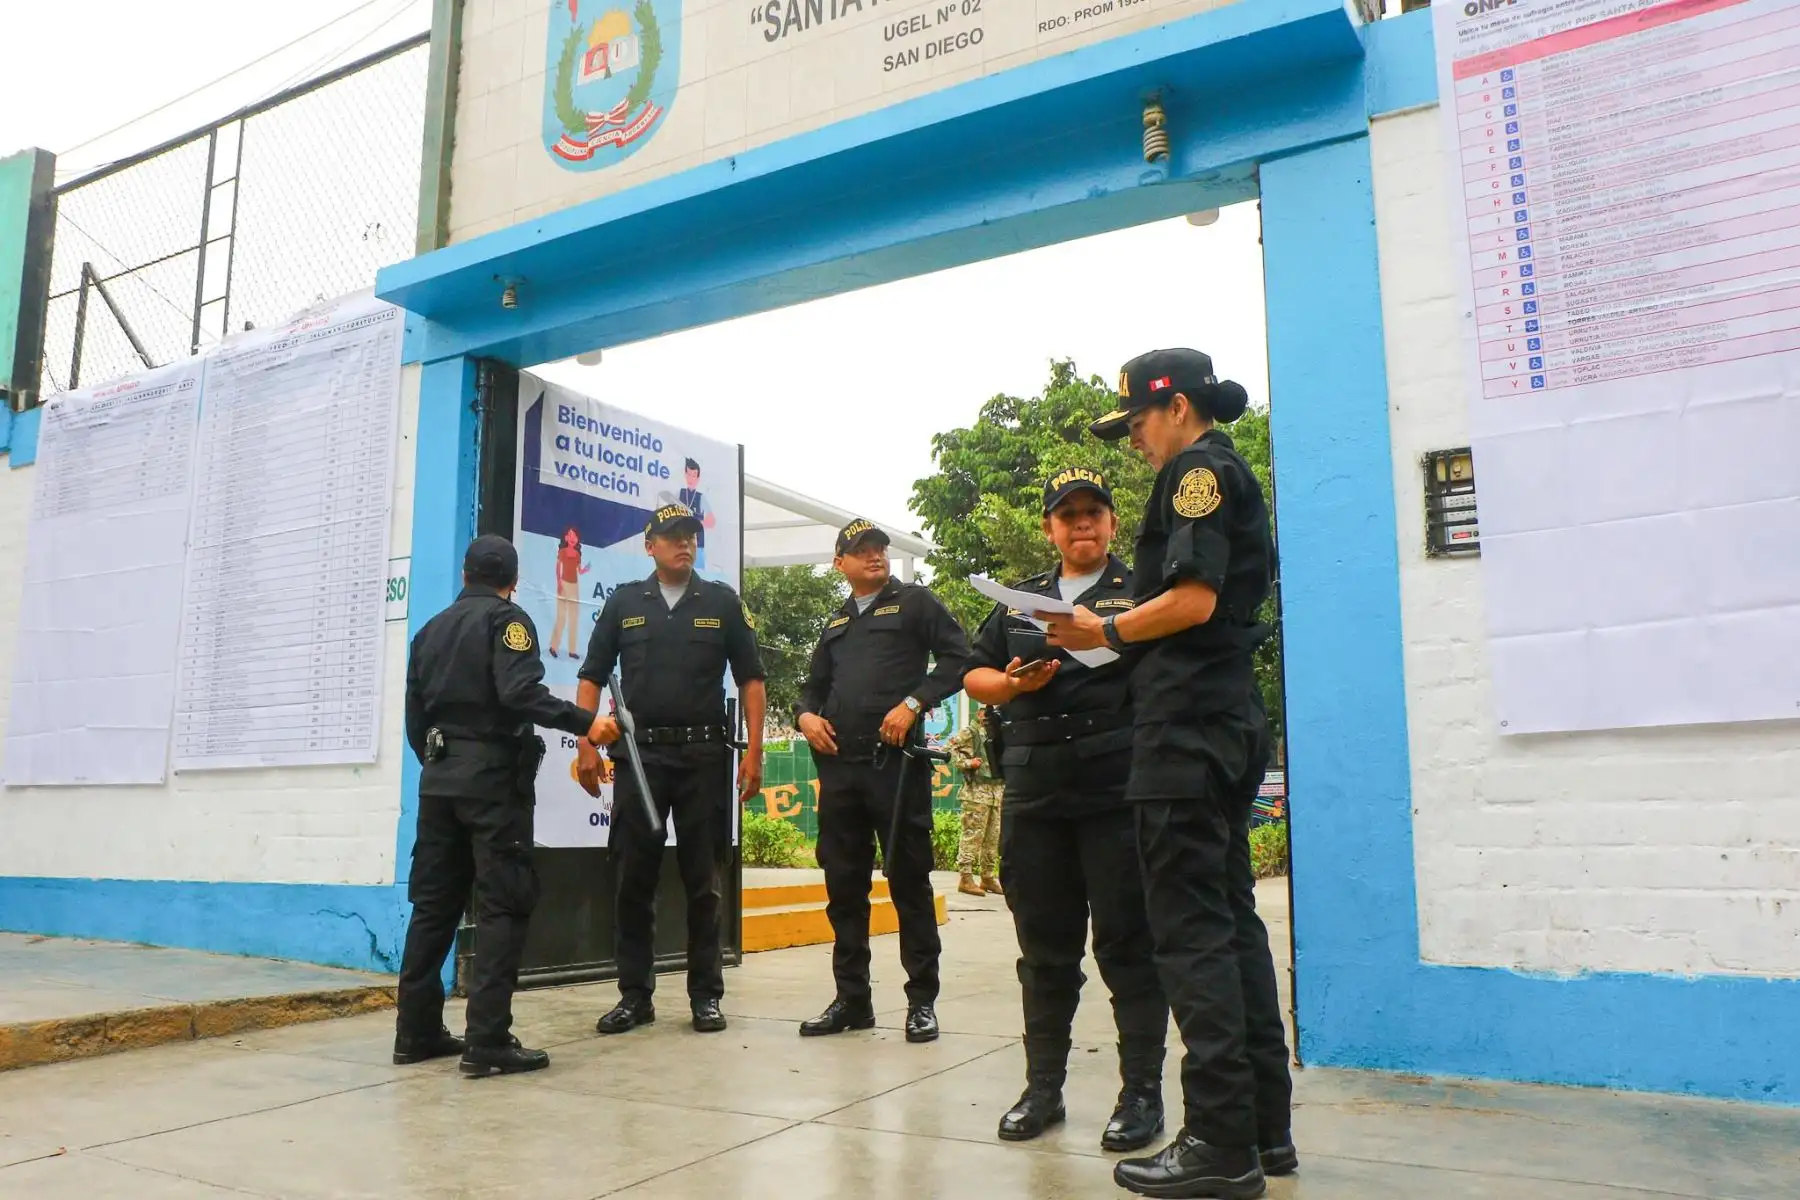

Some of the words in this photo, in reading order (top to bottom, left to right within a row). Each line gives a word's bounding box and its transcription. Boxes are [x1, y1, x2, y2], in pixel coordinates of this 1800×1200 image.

[1038, 15, 1070, 32] RDO:
[1074, 1, 1113, 21] PROM
[1599, 3, 1635, 17] SANTA
[884, 15, 932, 42] UGEL
[962, 0, 982, 16] 02
[1458, 26, 1479, 37] Ubica
[1490, 17, 1510, 27] mesa
[883, 46, 919, 72] SAN
[926, 27, 984, 60] DIEGO
[1568, 316, 1596, 326] TORRES
[1568, 326, 1600, 336] URRUTIA
[1570, 334, 1600, 345] URRUTIA
[1571, 344, 1601, 355] VALDIVIA
[1572, 354, 1600, 364] VARGAS
[1574, 374, 1598, 383] YUCRA
[558, 404, 663, 454] Bienvenido
[556, 434, 570, 452] a
[574, 436, 593, 459] tu
[598, 443, 643, 473] local
[647, 459, 670, 480] de
[554, 460, 640, 497] votación
[1051, 467, 1102, 492] POLICIA
